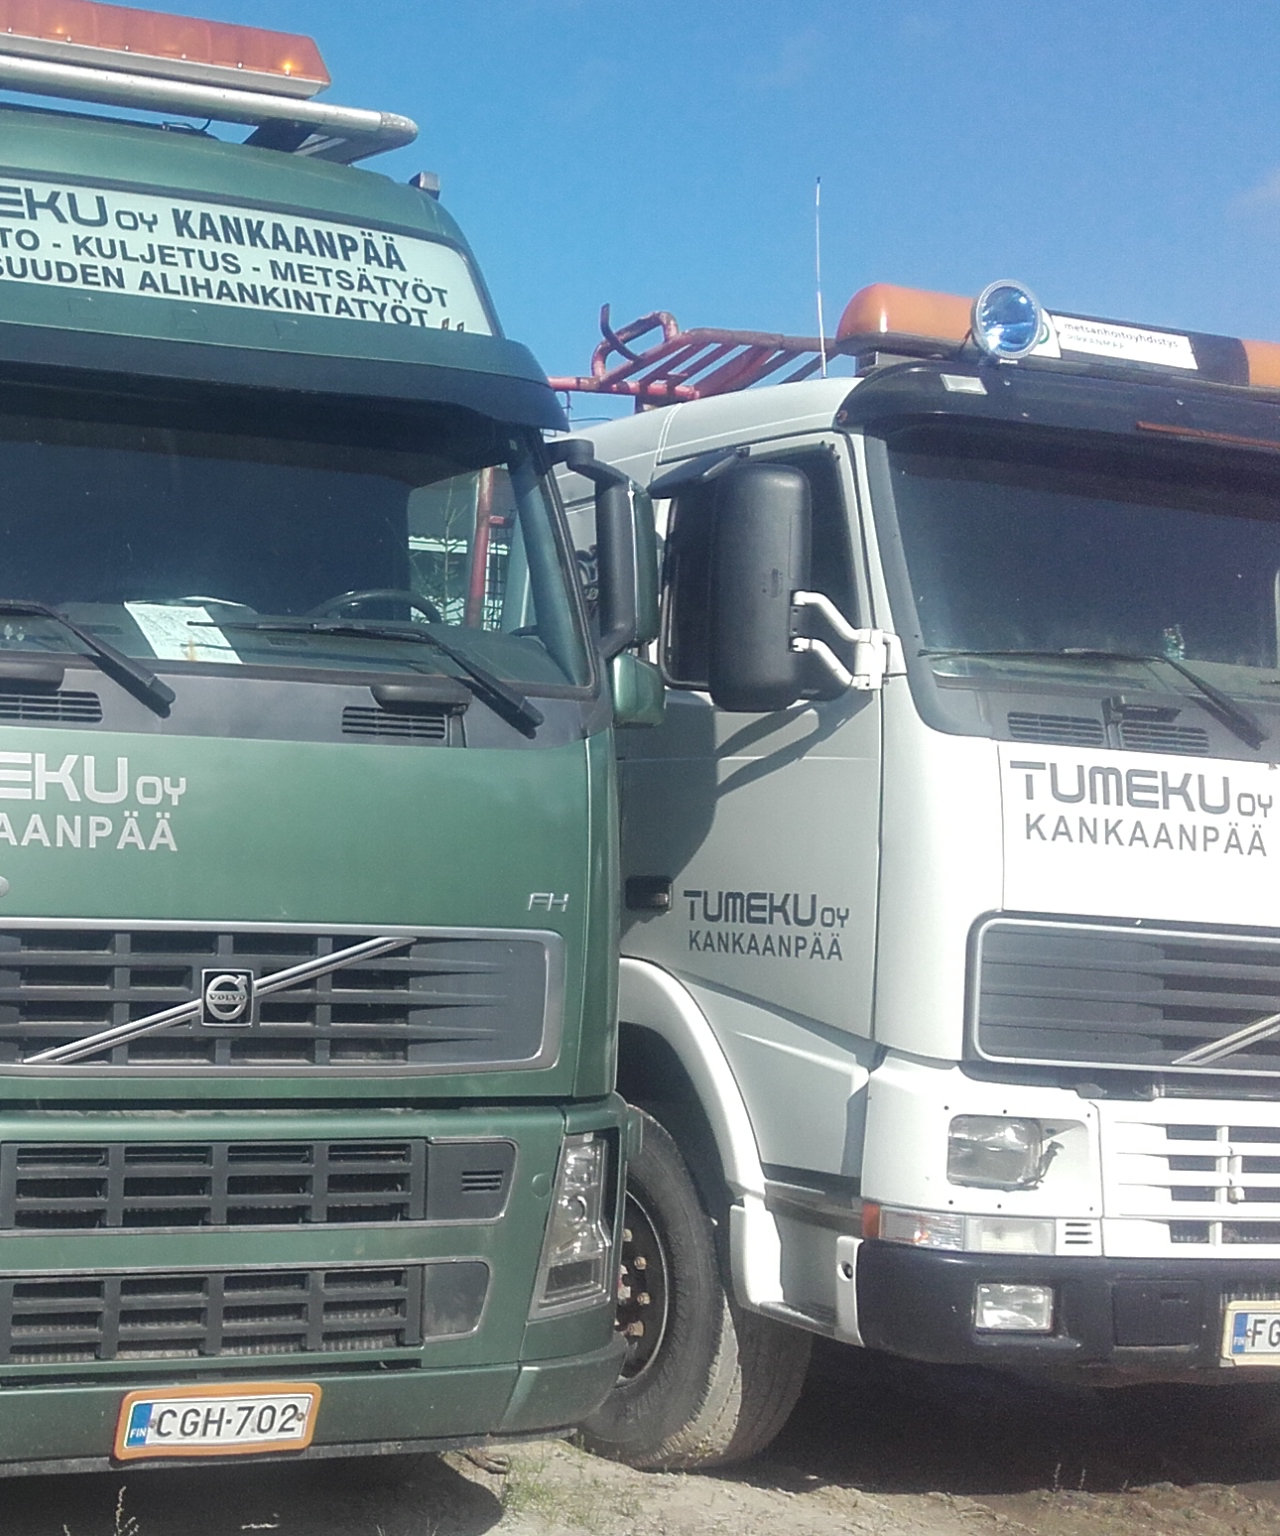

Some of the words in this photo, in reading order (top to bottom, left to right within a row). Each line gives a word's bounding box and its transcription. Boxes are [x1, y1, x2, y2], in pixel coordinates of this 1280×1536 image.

[115, 209, 159, 233] OY
[171, 207, 407, 272] KANKAANPÄÄ
[72, 234, 241, 275] KULJETUS
[269, 259, 448, 308] METSÄTYÖT
[138, 270, 428, 328] ALIHANKINTATYÖT
[136, 775, 187, 806] OY
[1009, 760, 1231, 815] TUMEKU
[1236, 792, 1273, 818] OY
[1025, 812, 1268, 857] KANKAANPÄÄ
[527, 892, 569, 912] FH
[683, 889, 817, 927] TUMEKU
[820, 907, 850, 928] OY
[688, 929, 843, 961] KANKAANPÄÄ
[129, 1427, 147, 1439] FIN
[156, 1403, 299, 1438] CGH-702
